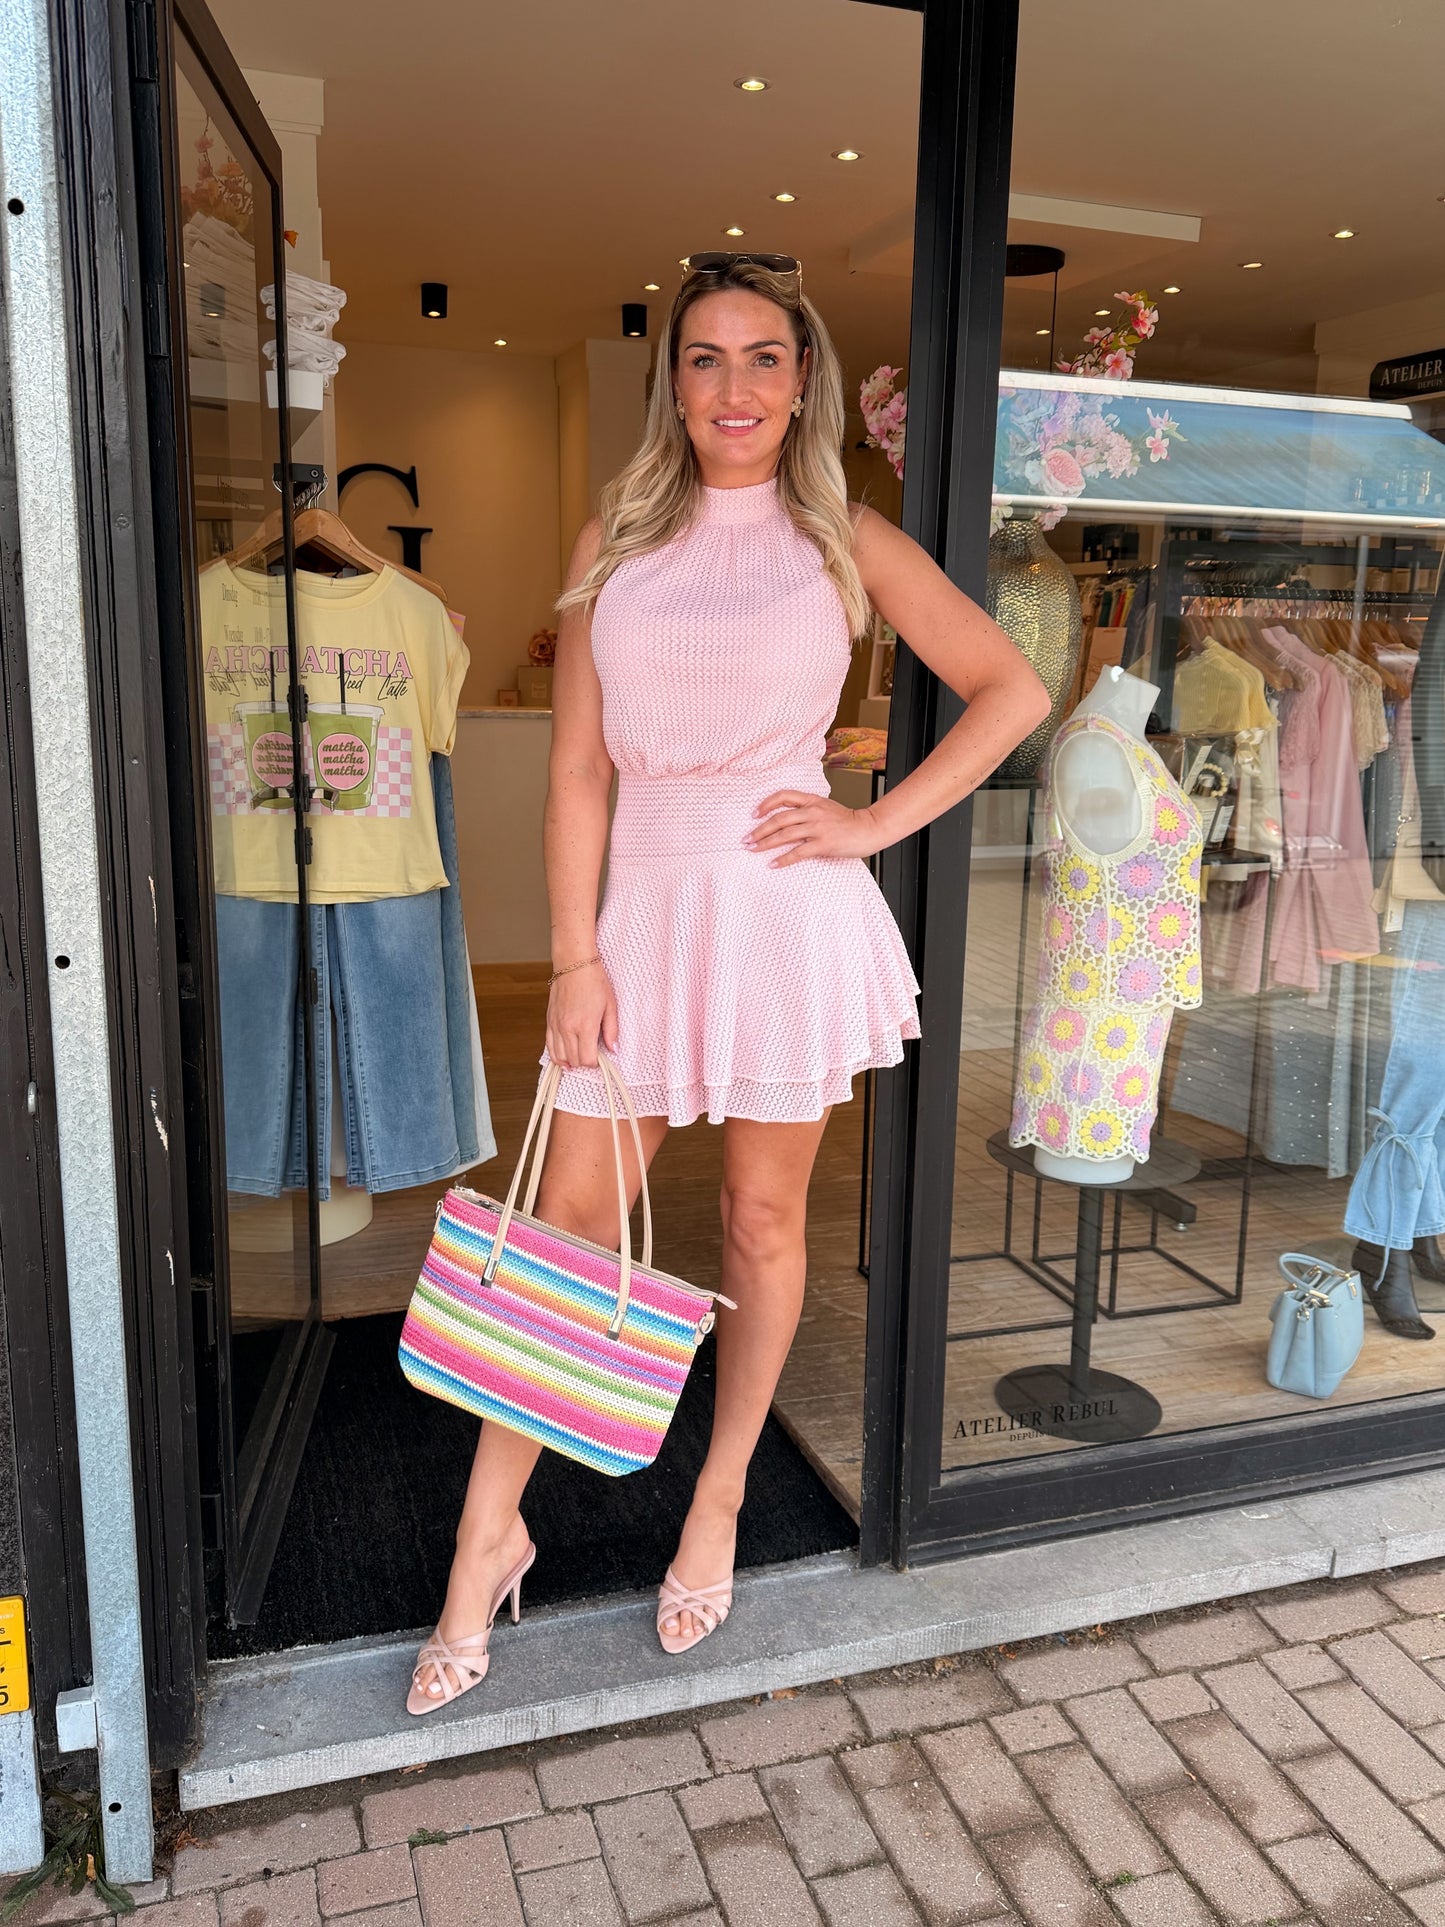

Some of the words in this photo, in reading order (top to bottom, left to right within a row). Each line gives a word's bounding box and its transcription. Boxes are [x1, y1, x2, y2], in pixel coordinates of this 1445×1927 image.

[1380, 359, 1443, 386] ATELIER
[300, 645, 413, 679] ATCHA
[377, 674, 408, 700] Latte
[322, 740, 365, 753] matcha
[322, 752, 365, 764] matcha
[324, 764, 366, 776] matcha
[952, 1410, 1044, 1439] ATELIER
[1052, 1399, 1119, 1423] REBUL
